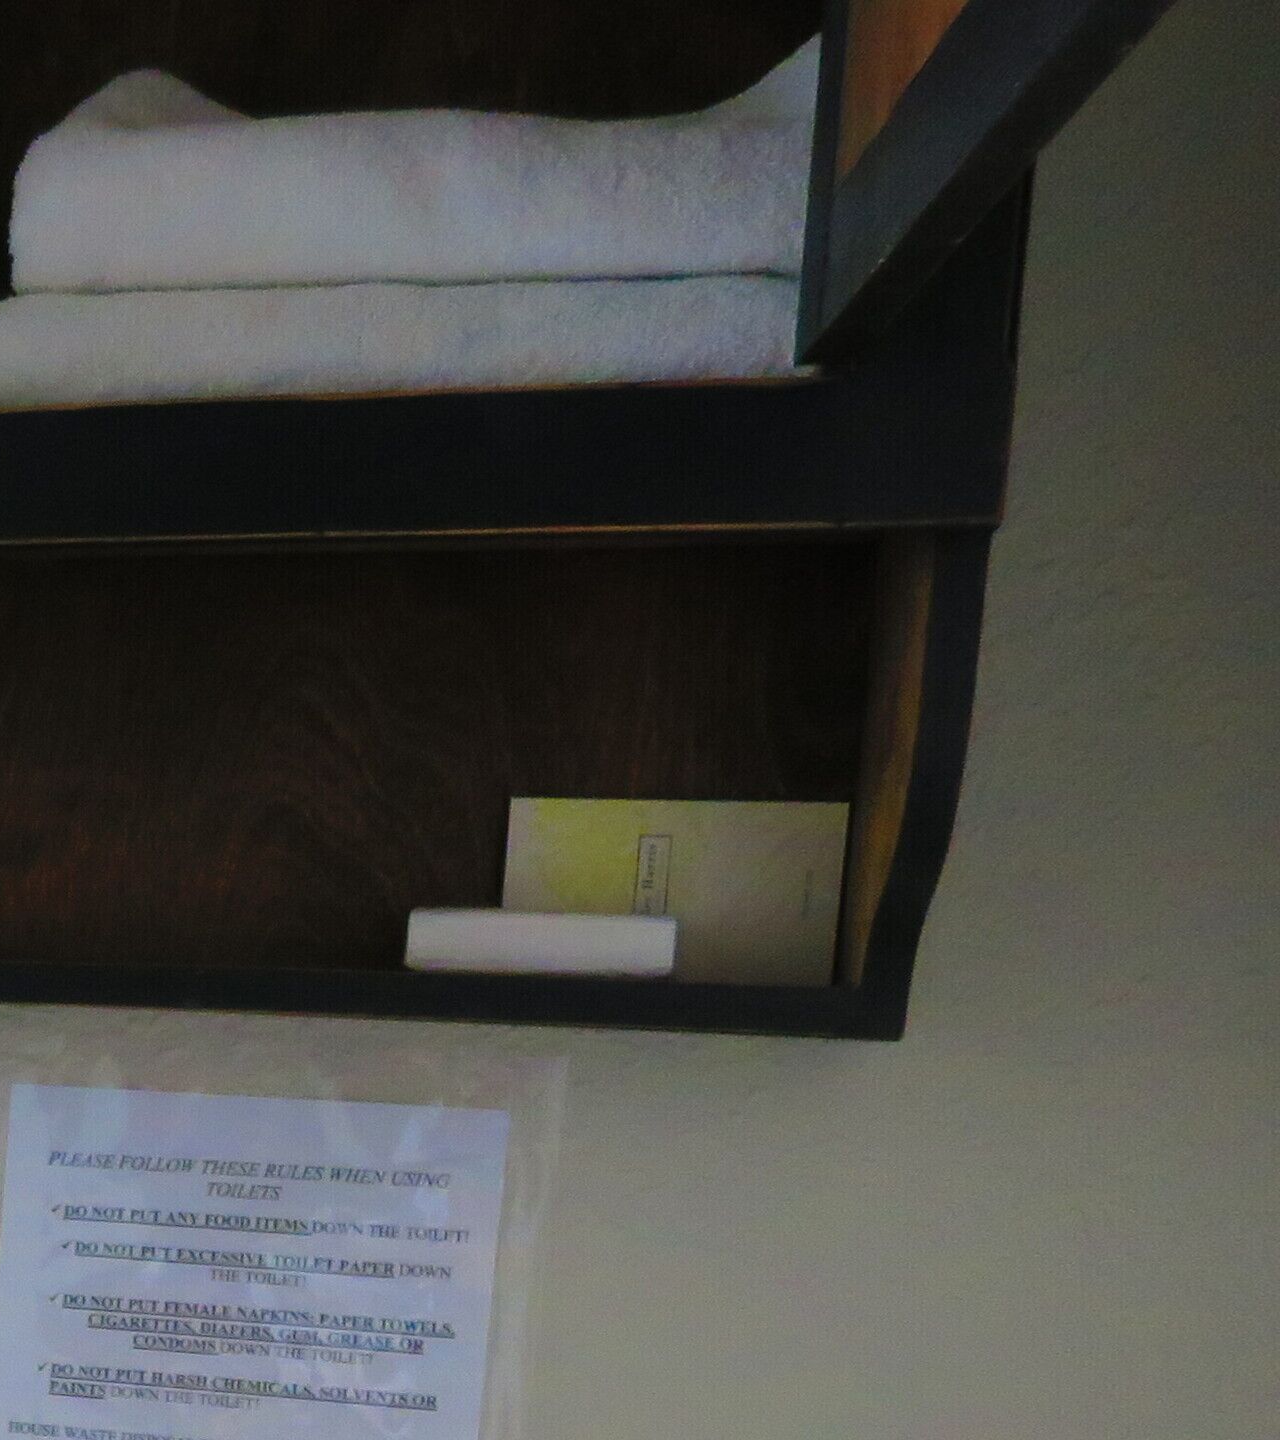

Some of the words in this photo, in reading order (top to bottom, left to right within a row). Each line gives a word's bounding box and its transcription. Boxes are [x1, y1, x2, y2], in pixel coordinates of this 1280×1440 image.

[50, 1151, 114, 1167] PLEASE
[120, 1156, 193, 1173] FOLLOW
[203, 1161, 259, 1177] THESE
[264, 1165, 324, 1181] RULES
[330, 1169, 385, 1185] WHEN
[392, 1173, 451, 1190] USING
[208, 1183, 281, 1199] TOILETS
[65, 1204, 88, 1218] DO
[90, 1206, 126, 1221] NOT
[131, 1209, 160, 1223] PUT
[165, 1211, 197, 1226] ANY
[205, 1214, 251, 1229] FOOD
[255, 1217, 309, 1234] ITEMS
[313, 1221, 363, 1237] DOWN
[370, 1225, 399, 1240] THE
[76, 1241, 98, 1254] DO
[102, 1243, 138, 1257] NOT
[143, 1246, 170, 1259] PUT
[177, 1249, 262, 1266] EXCESSIVE
[275, 1256, 333, 1272] TOILET
[341, 1261, 395, 1276] PAPER
[401, 1265, 452, 1281] DOWN
[211, 1269, 240, 1282] THE
[64, 1294, 88, 1307] DO
[91, 1296, 122, 1309] NOT
[129, 1299, 157, 1312] PUT
[164, 1302, 230, 1318] FEMALE
[320, 1315, 374, 1330] PAPER
[134, 1335, 217, 1352] CONDOMS
[221, 1342, 270, 1356] DOWN
[277, 1347, 306, 1359] THE
[328, 1333, 392, 1350] GREASE
[399, 1339, 424, 1352] OR
[50, 1381, 105, 1396] PAINTS
[111, 1386, 159, 1401] DOWN
[165, 1391, 194, 1404] THE
[51, 1363, 74, 1377] DO
[79, 1366, 110, 1380] NOT
[116, 1369, 145, 1383] PUT
[152, 1372, 207, 1388] HARSH
[319, 1387, 408, 1406] SOLVENTS
[412, 1395, 438, 1409] OR
[8, 1421, 60, 1438] HOUSE
